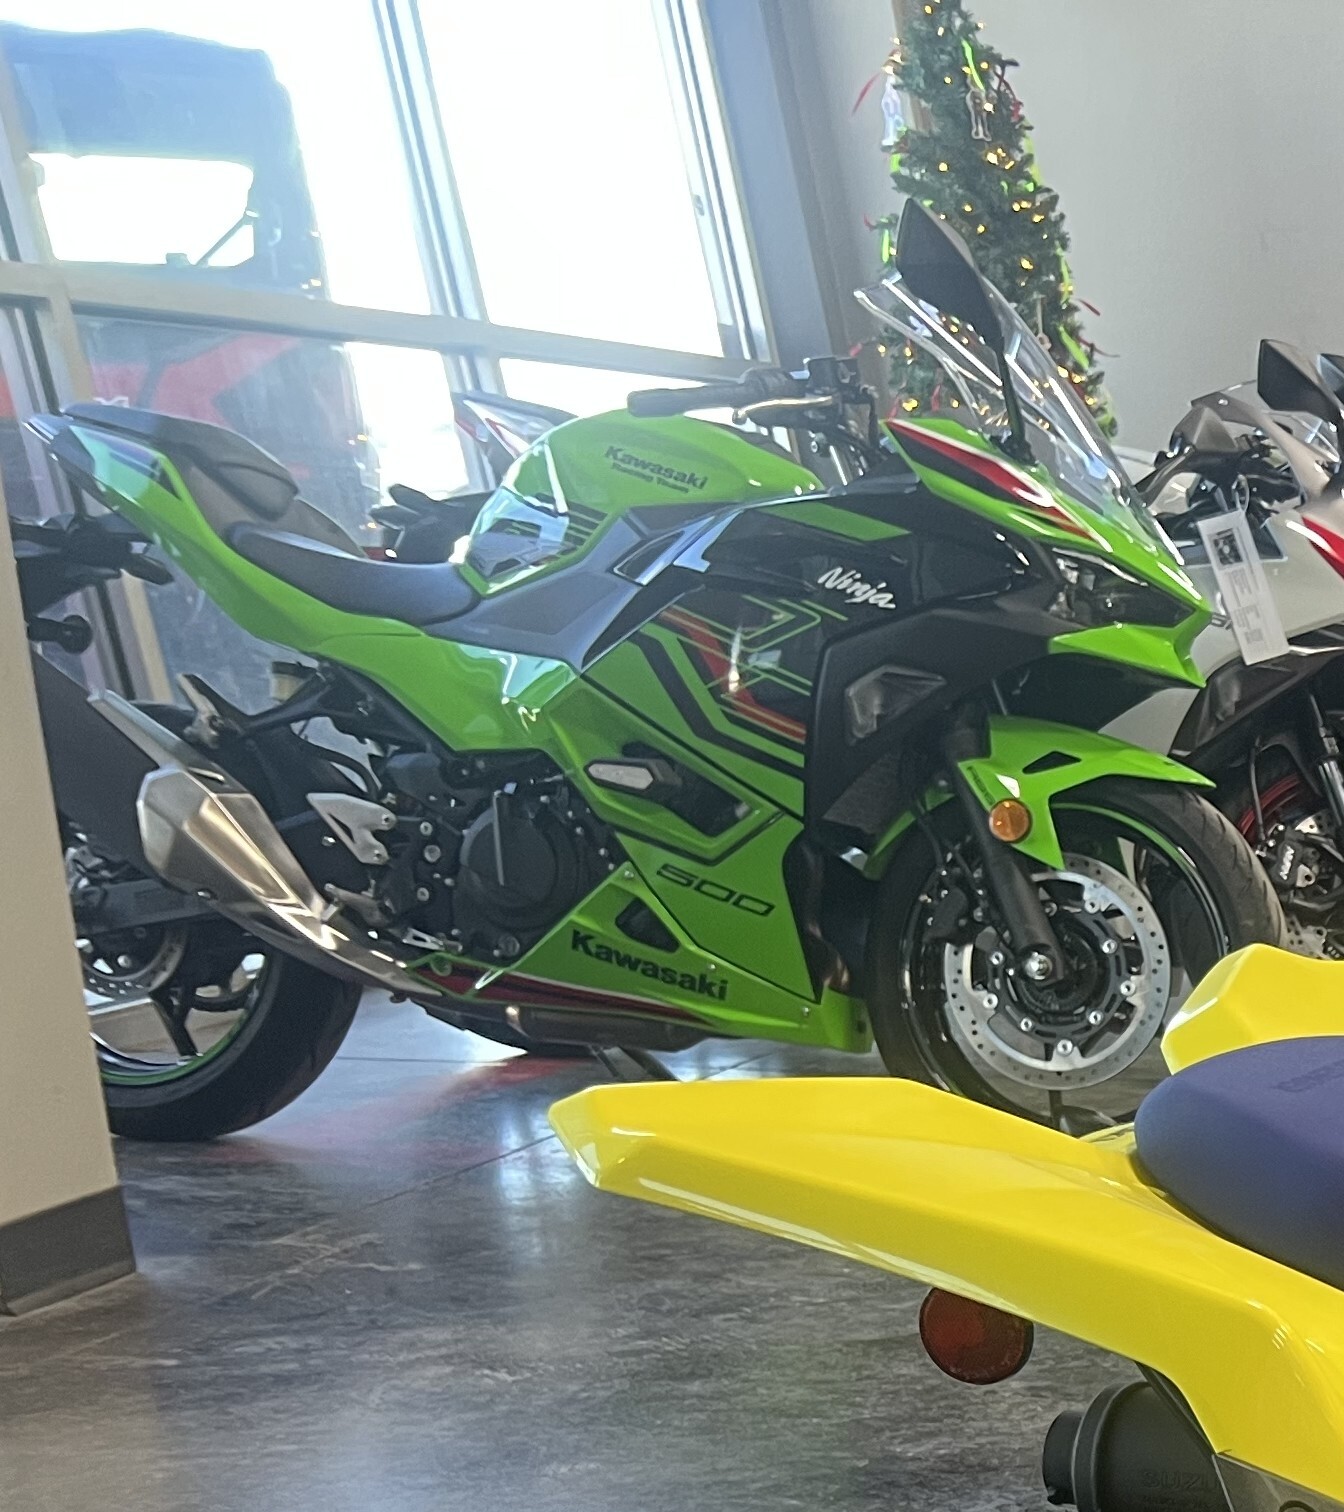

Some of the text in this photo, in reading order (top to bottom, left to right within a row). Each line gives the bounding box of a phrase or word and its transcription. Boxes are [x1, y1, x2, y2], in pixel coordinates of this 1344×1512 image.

[604, 446, 708, 490] Kawasaki
[817, 567, 897, 609] Ninja
[656, 863, 775, 917] 500
[571, 928, 728, 1001] Kawasaki
